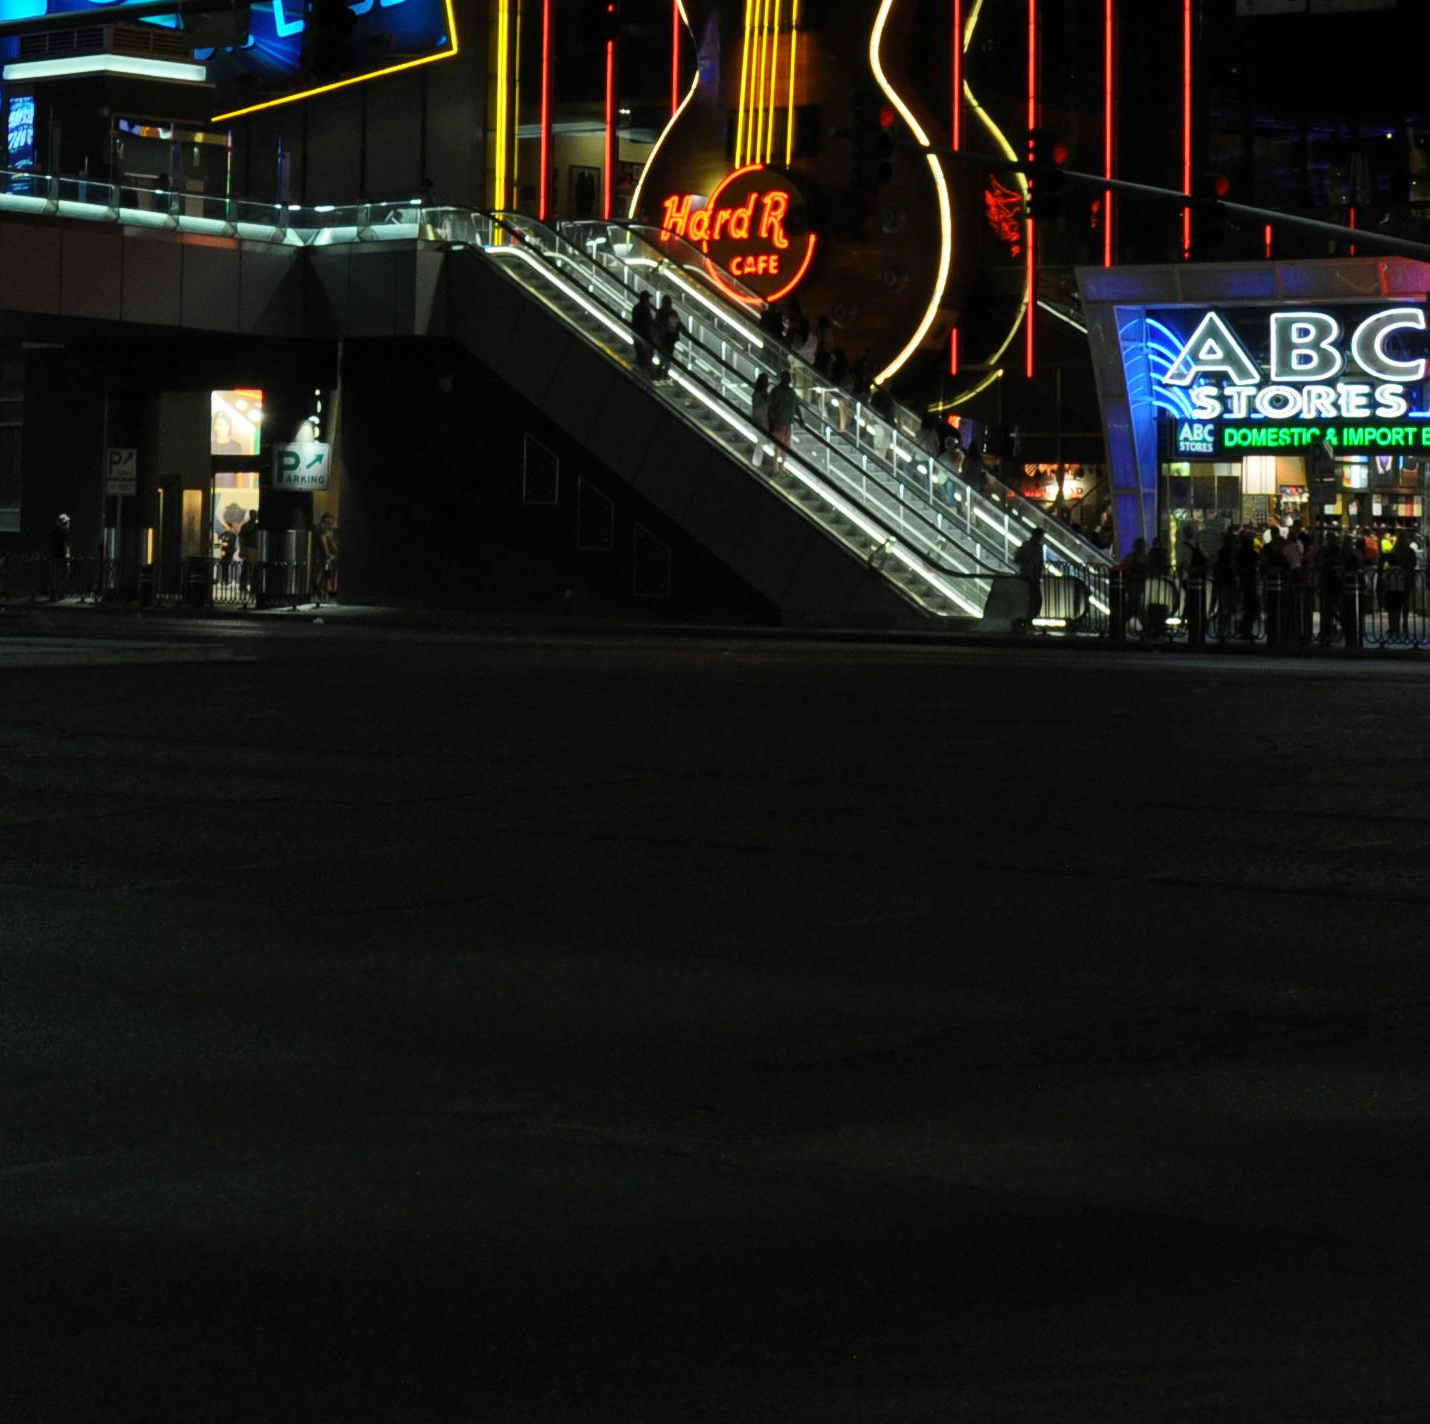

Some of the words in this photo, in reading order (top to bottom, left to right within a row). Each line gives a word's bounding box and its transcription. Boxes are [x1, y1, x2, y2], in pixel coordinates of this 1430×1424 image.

[660, 192, 759, 242] Hard
[730, 255, 780, 276] CAFE
[1162, 307, 1428, 386] ABC
[1189, 382, 1408, 421] STORES
[1179, 423, 1214, 442] ABC
[1224, 428, 1321, 447] DOMESTIC
[1324, 427, 1338, 446] &
[1343, 427, 1417, 447] IMPORT
[1179, 441, 1214, 453] STORES
